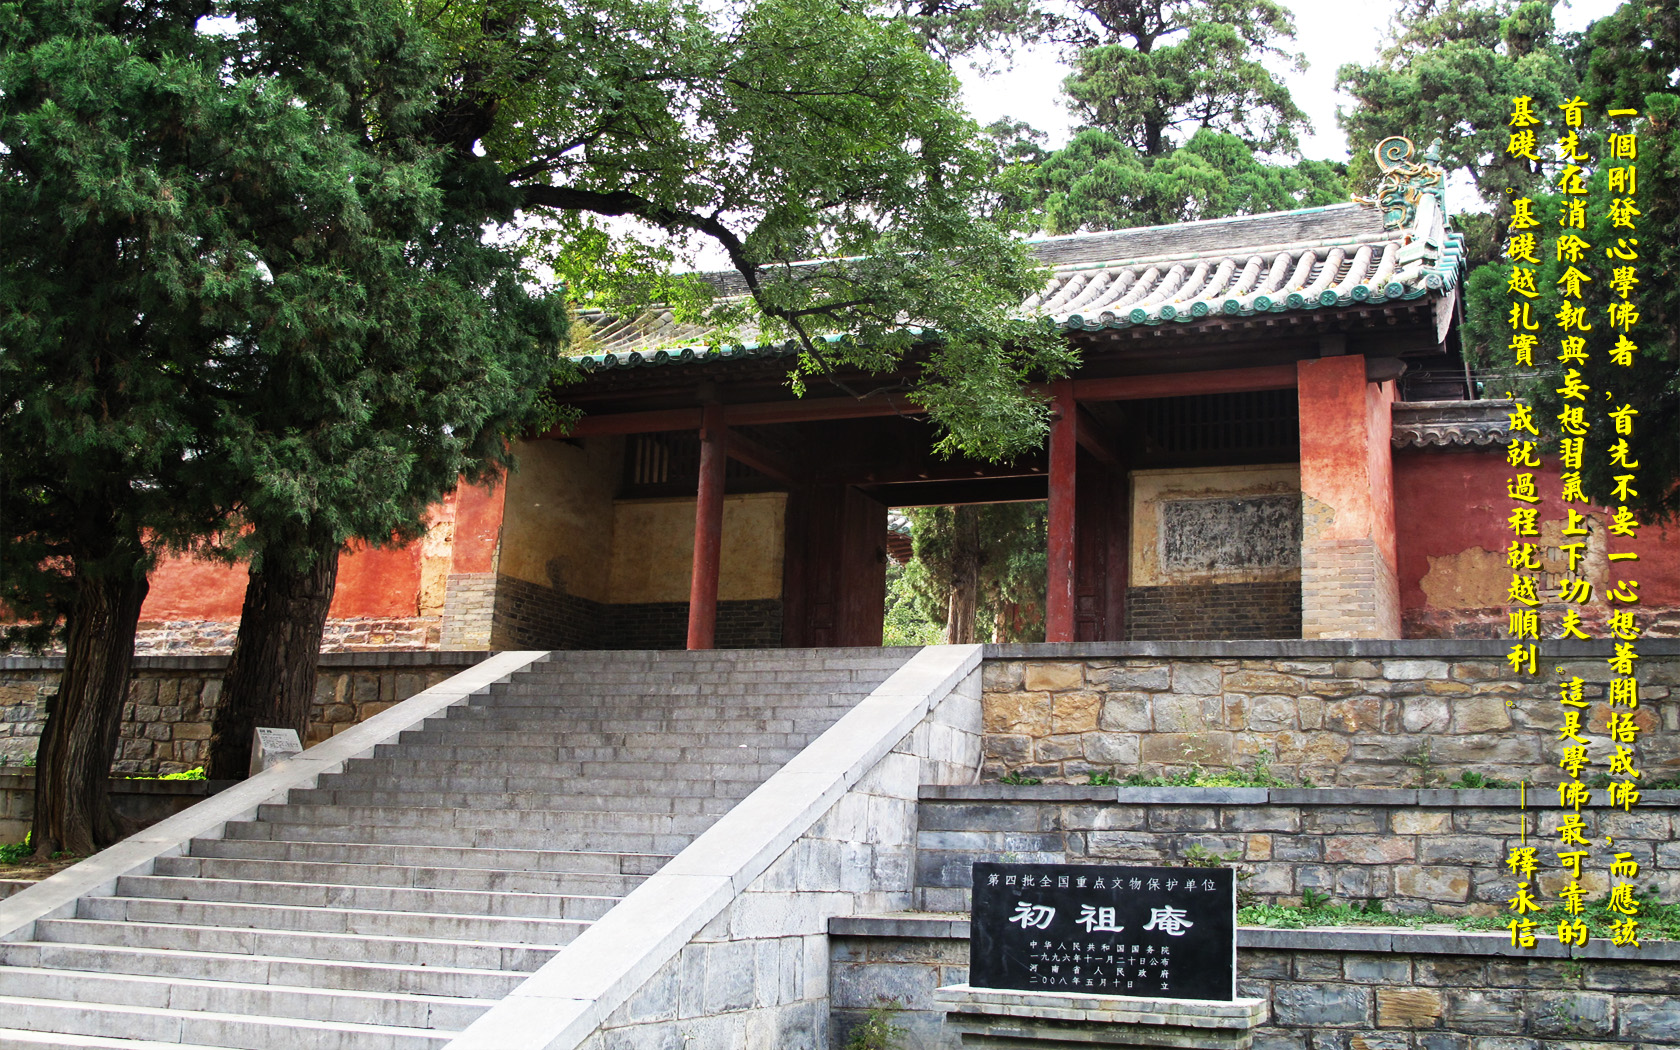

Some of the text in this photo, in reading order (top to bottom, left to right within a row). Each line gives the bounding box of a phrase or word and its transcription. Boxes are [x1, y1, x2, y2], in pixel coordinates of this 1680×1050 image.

[987, 873, 1217, 892] 第四批全国重点文物保护单位
[1008, 901, 1194, 936] 初祖庵
[1029, 940, 1170, 955] 中华人民共和国国务院
[1030, 952, 1170, 966] 一九九六年十一月二十日公布
[1029, 963, 1170, 979] 河南省人民政府
